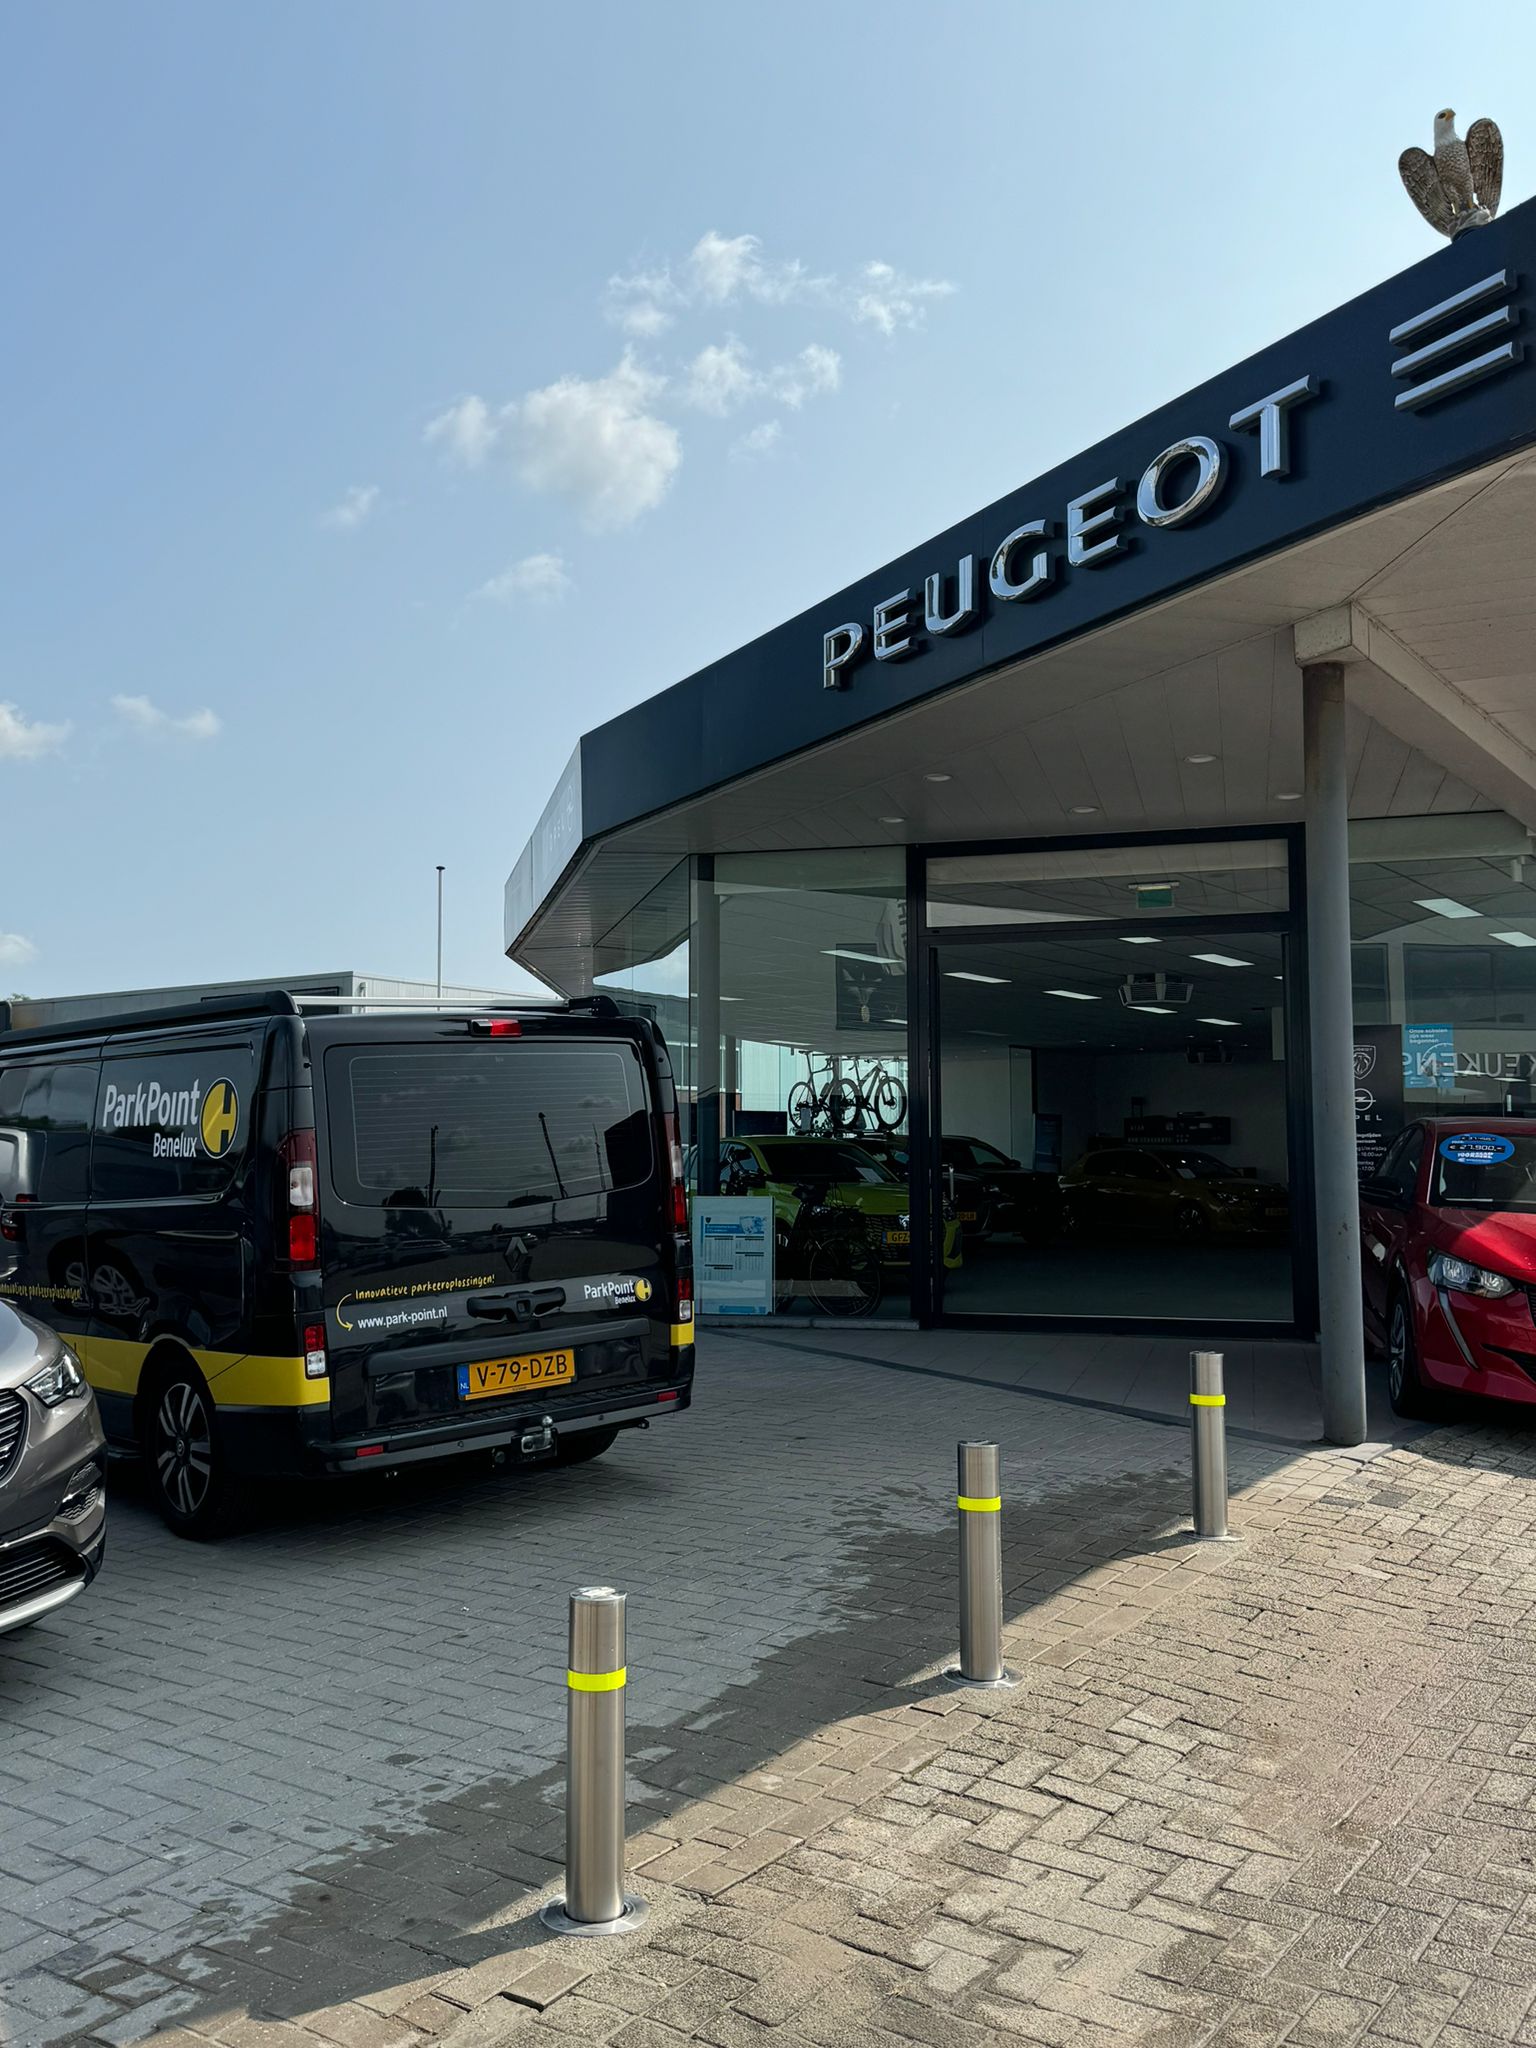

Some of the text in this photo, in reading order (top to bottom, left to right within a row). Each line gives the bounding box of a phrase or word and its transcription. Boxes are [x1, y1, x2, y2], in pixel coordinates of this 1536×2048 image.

[822, 374, 1320, 690] PEUGEOT
[103, 1079, 200, 1127] ParkPoint
[152, 1131, 198, 1158] Benelux
[355, 1274, 495, 1300] Innovatieve parkeeroplossingen!
[584, 1280, 635, 1299] ParkPoint
[614, 1295, 637, 1305] Benelux
[357, 1306, 448, 1329] www.park-point.nl
[477, 1354, 568, 1387] V-79-DZB
